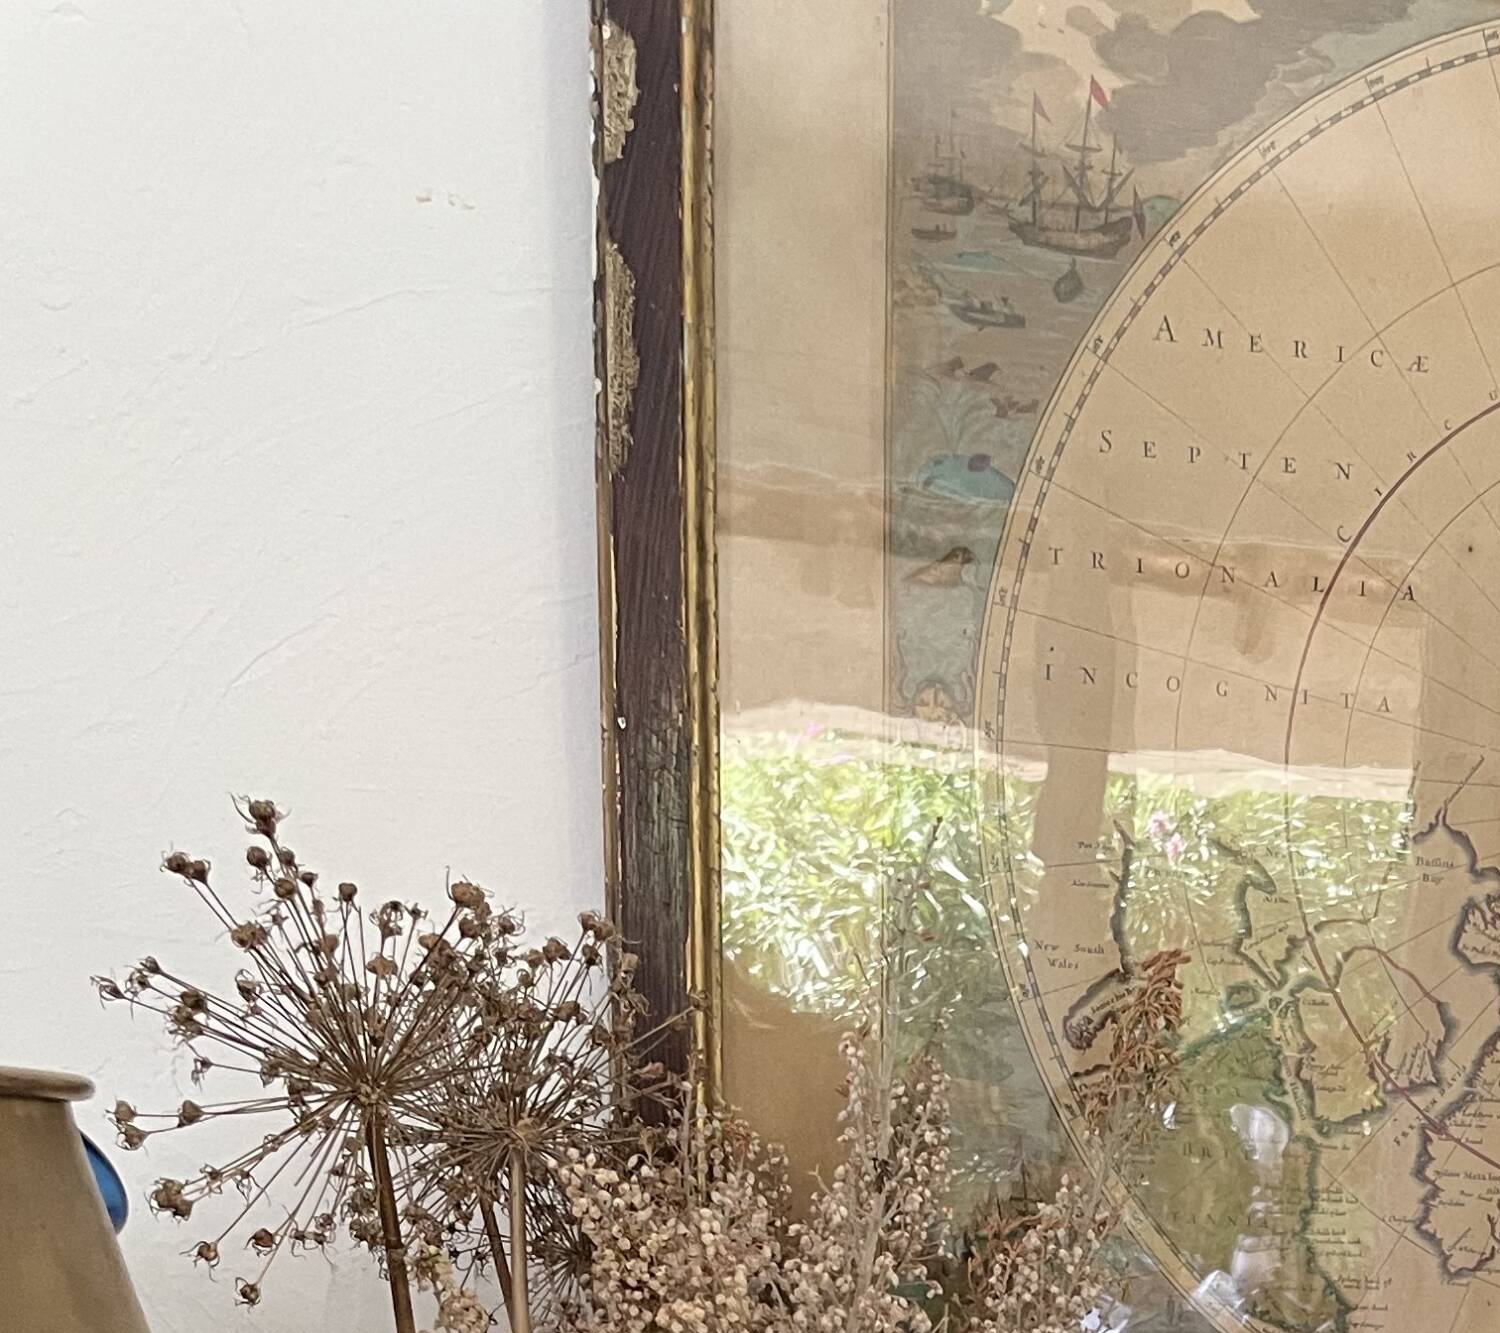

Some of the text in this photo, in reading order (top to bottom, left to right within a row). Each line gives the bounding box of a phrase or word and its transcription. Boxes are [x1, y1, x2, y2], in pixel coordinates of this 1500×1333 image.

[1098, 429, 1354, 481] SEPTEN
[1047, 546, 1417, 602] TRIONALIA
[1044, 663, 1391, 714] INCOGNITA
